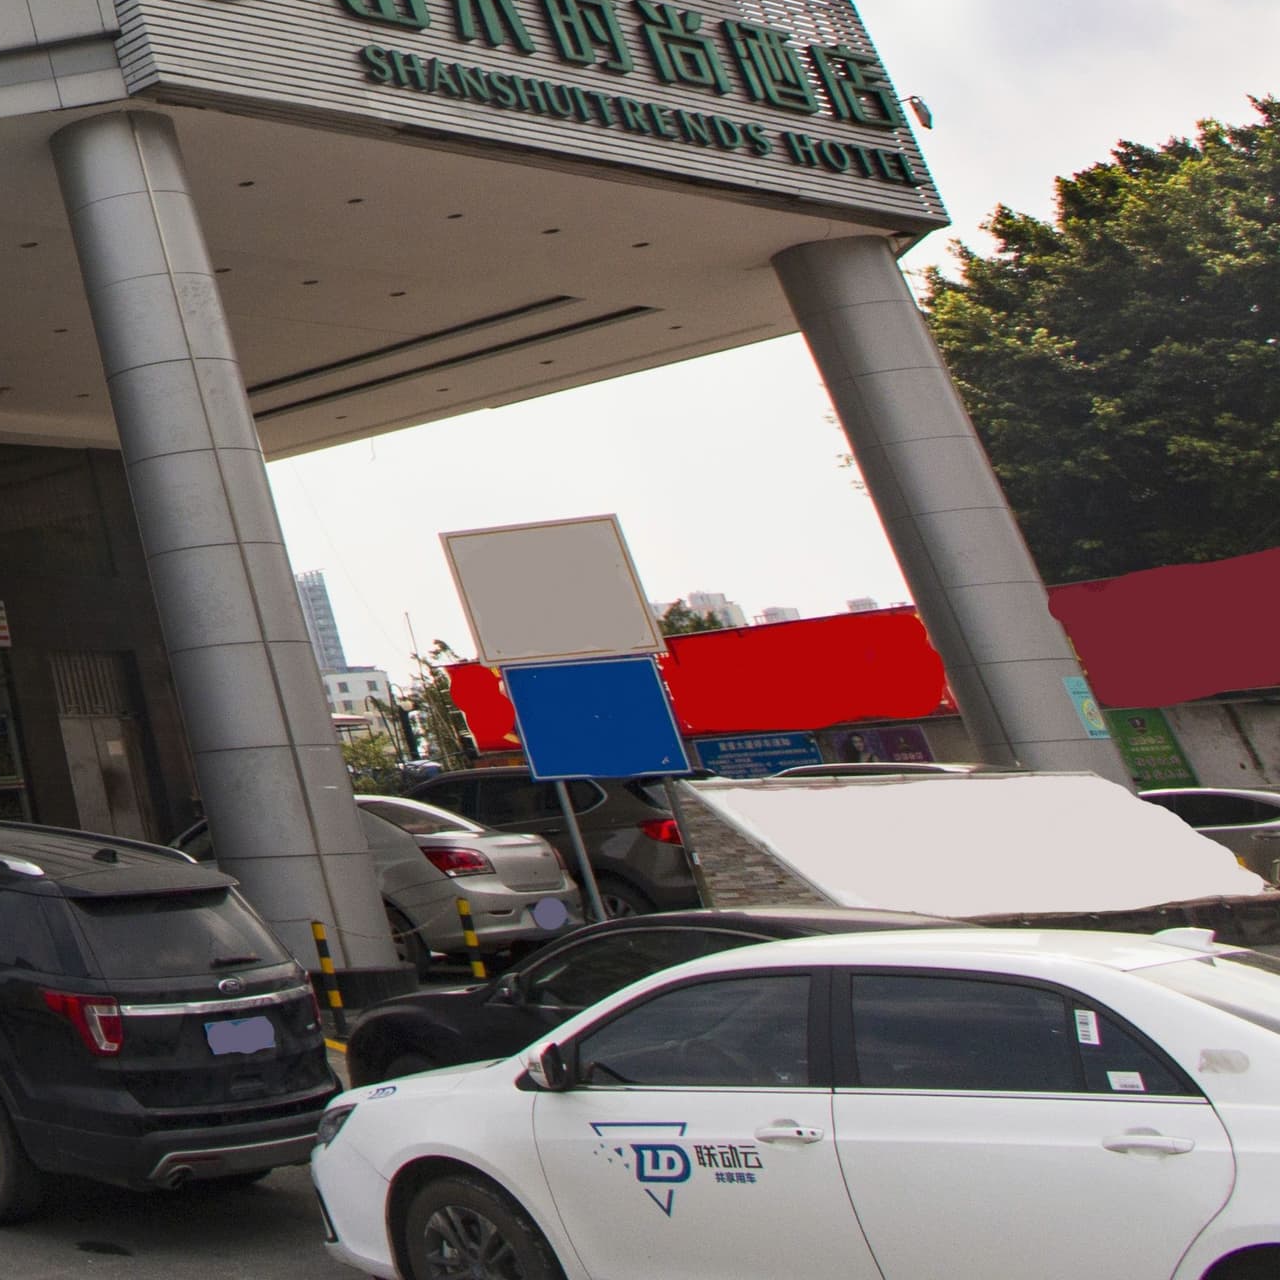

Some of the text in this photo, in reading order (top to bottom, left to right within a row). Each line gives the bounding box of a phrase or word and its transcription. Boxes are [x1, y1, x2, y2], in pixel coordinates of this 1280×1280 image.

[782, 131, 922, 187] HOTEL
[694, 1144, 763, 1169] 联动云
[715, 1171, 757, 1185] 共享用车
